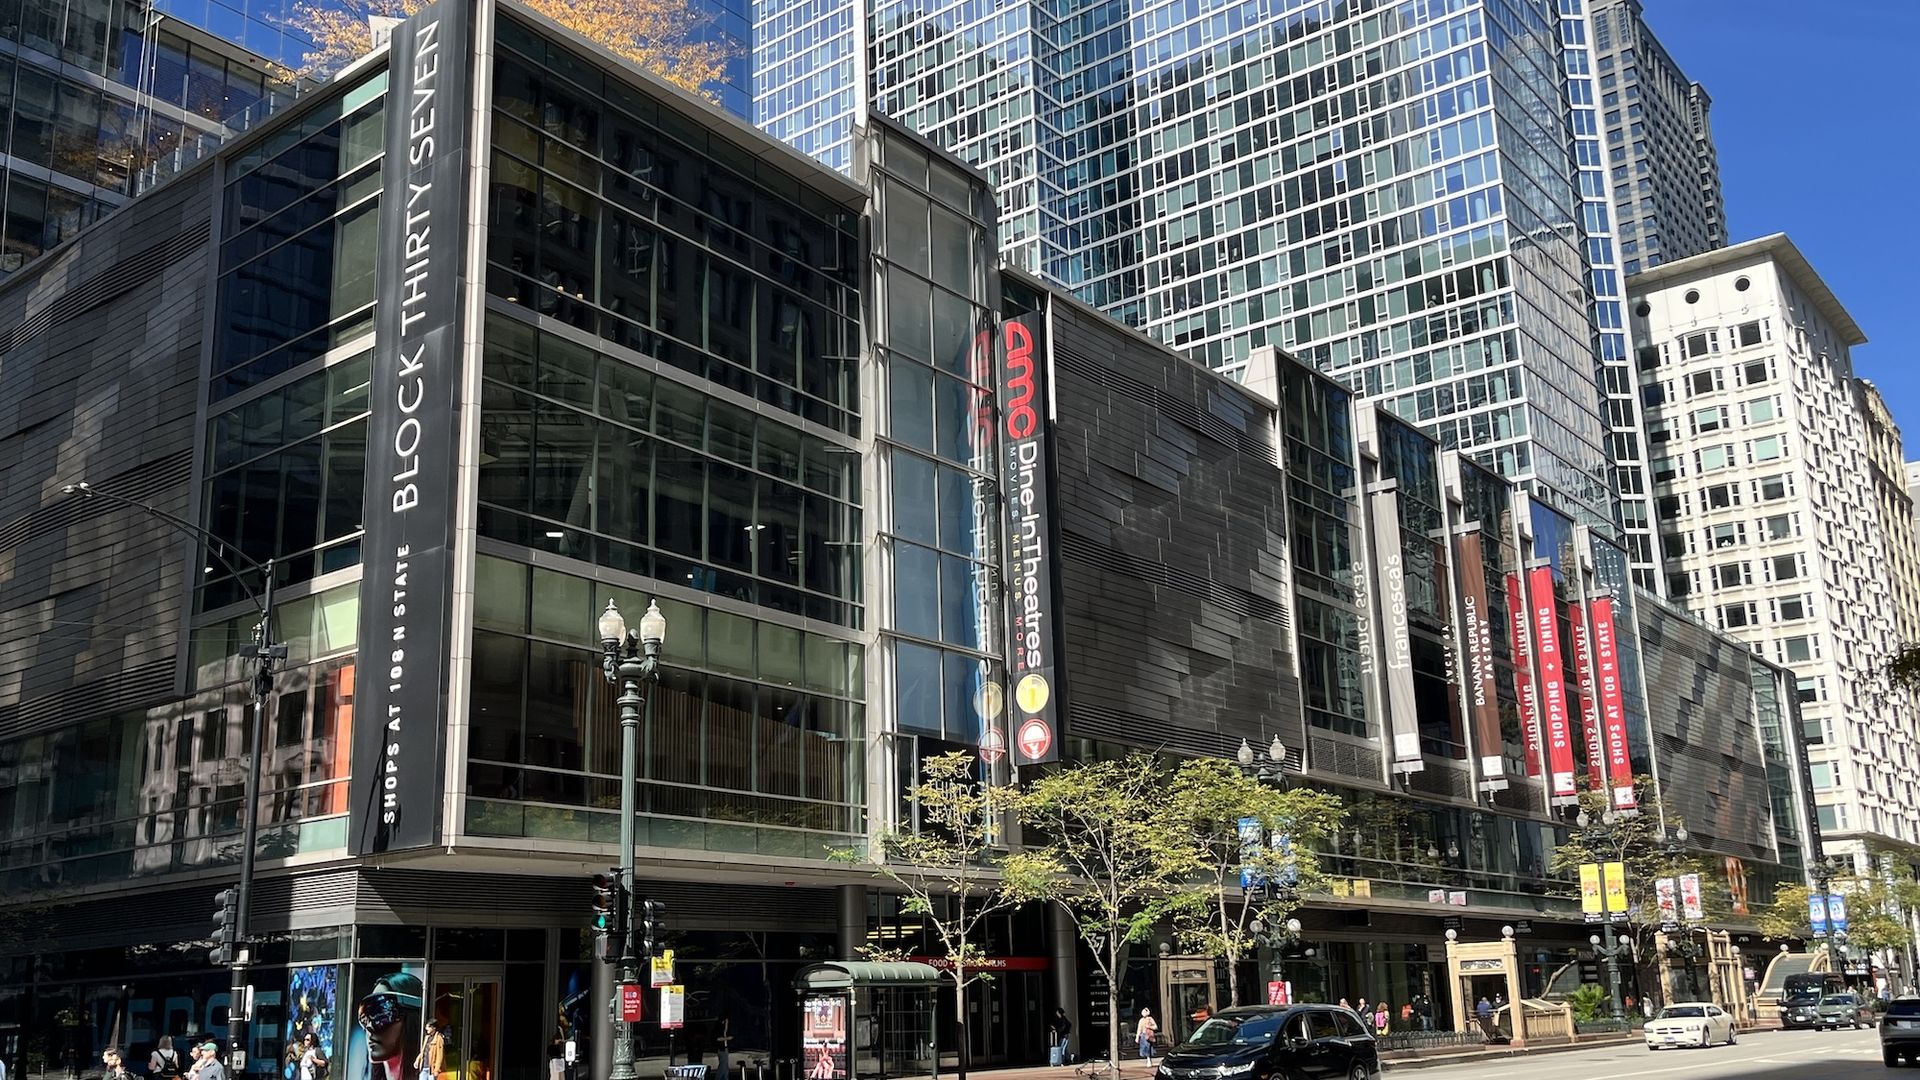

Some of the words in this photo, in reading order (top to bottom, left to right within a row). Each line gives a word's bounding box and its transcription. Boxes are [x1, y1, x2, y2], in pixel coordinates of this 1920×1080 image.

[409, 19, 440, 166] SEVEN
[402, 183, 432, 337] THIRTY
[1005, 321, 1037, 440] amc
[393, 343, 425, 513] BLOCK
[394, 544, 410, 618] STATE
[393, 626, 406, 641] N
[1383, 554, 1410, 670] francesca's
[1465, 595, 1480, 653] REPUBLIC
[1539, 607, 1554, 653] DINING
[1480, 619, 1492, 679] FACTORY
[1598, 621, 1612, 657] STATE
[390, 649, 404, 692] 108
[1472, 654, 1486, 706] BANANA
[1603, 662, 1612, 670] N
[1604, 676, 1615, 699] 108
[387, 705, 400, 732] AT
[1547, 681, 1565, 748] SHOPPING
[1607, 705, 1620, 719] AT
[1609, 724, 1624, 765] SHOPS
[384, 743, 399, 823] SHOPS
[929, 959, 948, 967] FOOD
